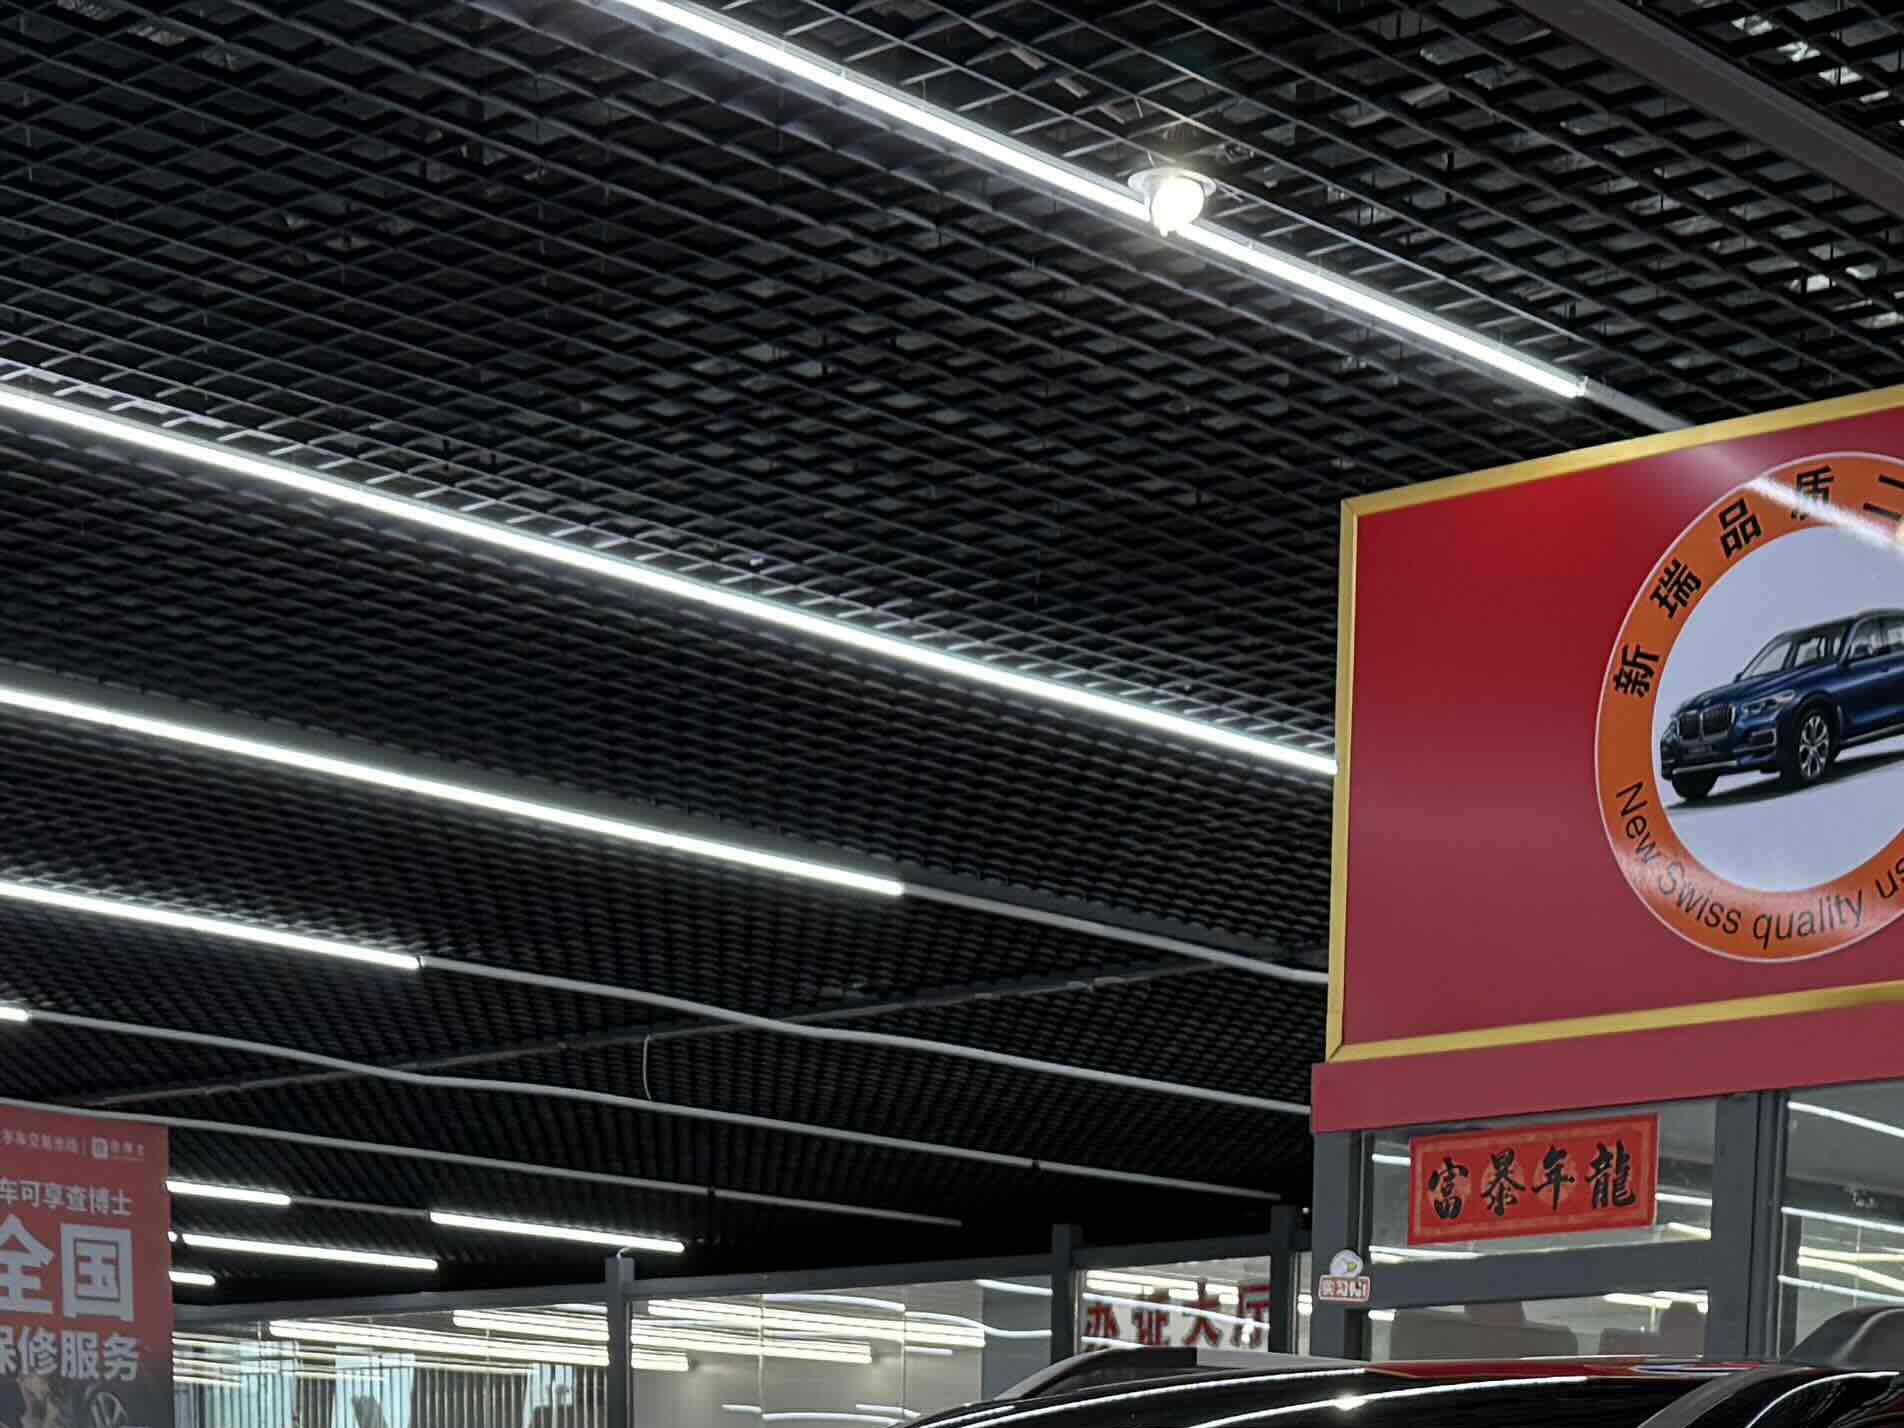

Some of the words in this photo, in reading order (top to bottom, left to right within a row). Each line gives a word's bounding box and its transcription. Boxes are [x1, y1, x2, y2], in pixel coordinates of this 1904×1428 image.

[1616, 781, 1659, 866] New
[1658, 860, 1742, 936] Swiss
[1752, 889, 1864, 951] quality
